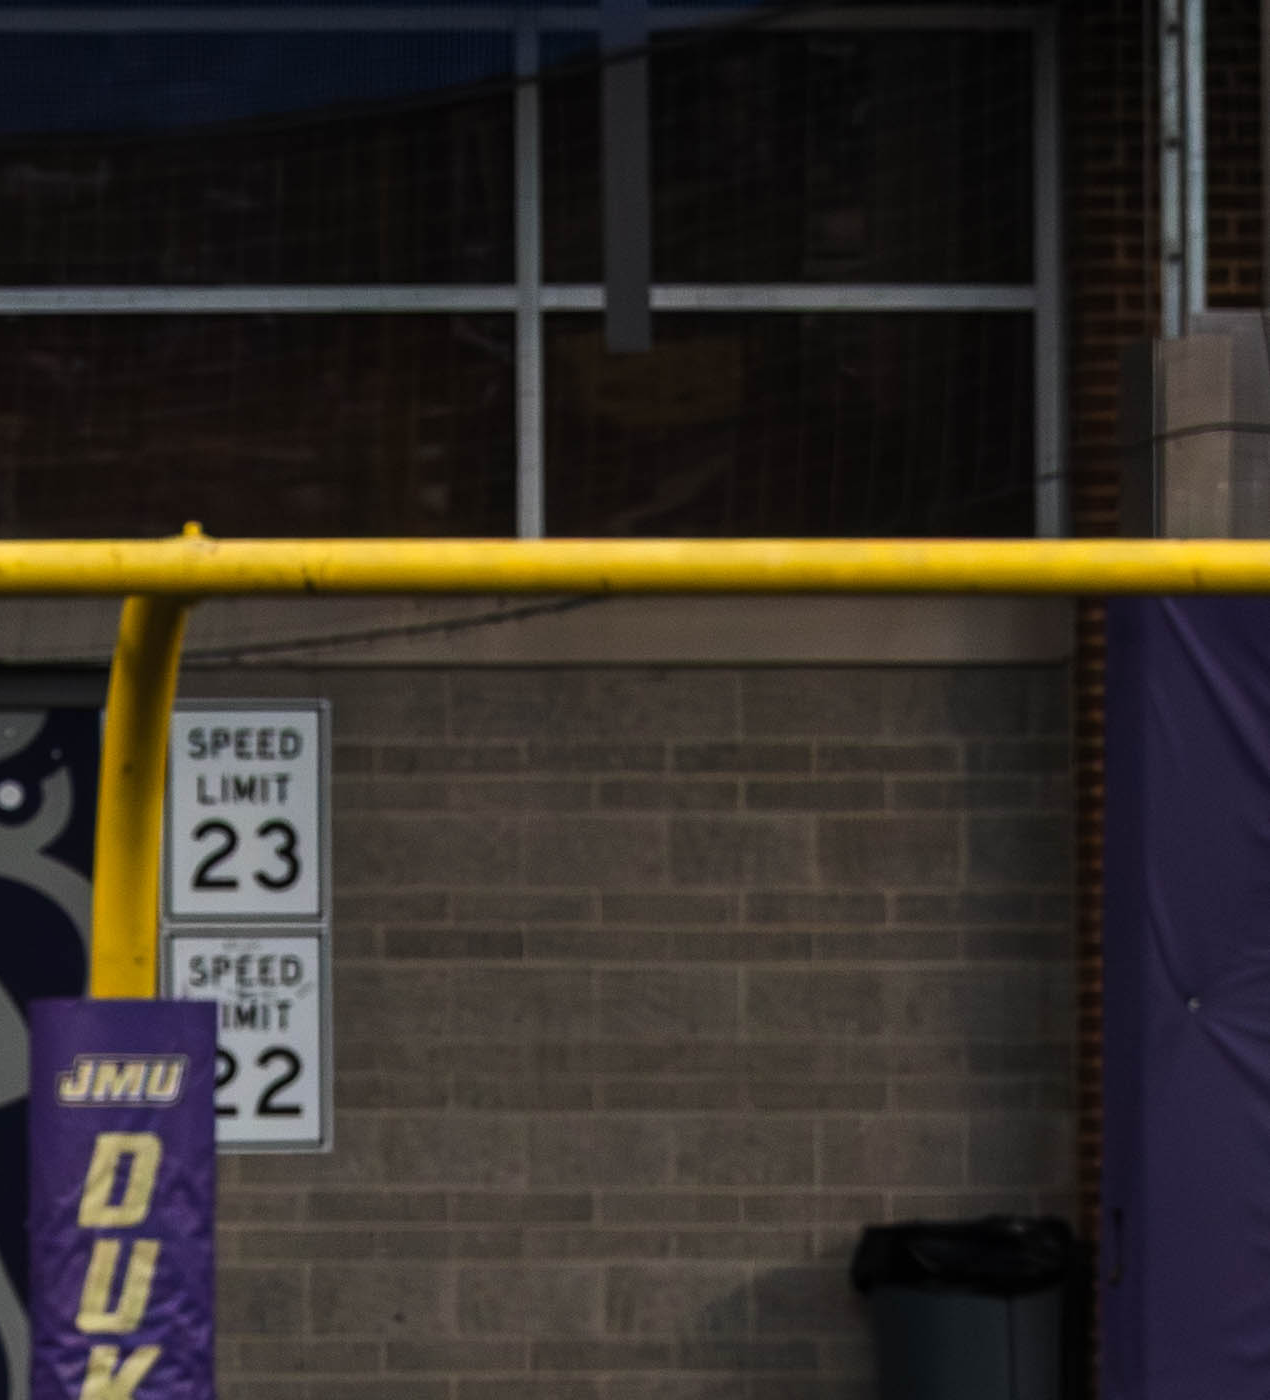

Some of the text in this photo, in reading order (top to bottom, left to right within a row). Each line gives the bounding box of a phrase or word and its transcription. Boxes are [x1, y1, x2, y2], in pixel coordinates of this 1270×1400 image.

[187, 726, 303, 761] SPEED
[196, 773, 293, 805] LIMIT
[191, 819, 301, 892] 23
[188, 955, 304, 988] SPEED
[217, 1001, 293, 1032] IMIT
[58, 1056, 188, 1106] JMU
